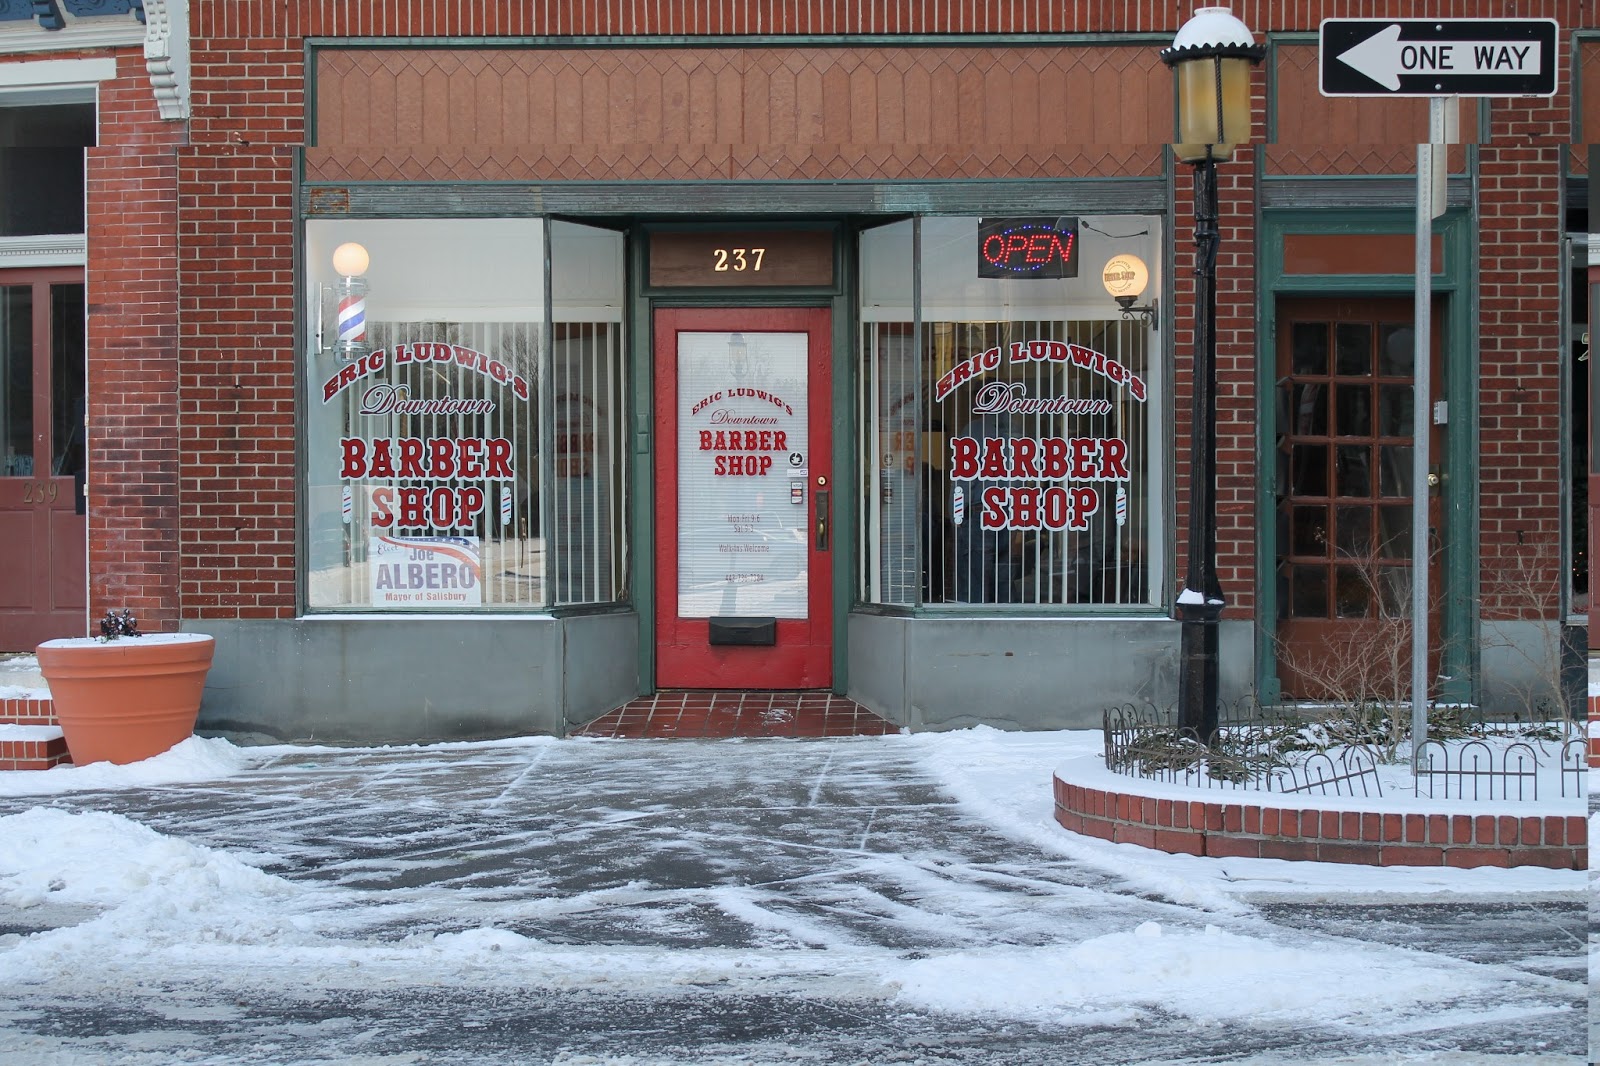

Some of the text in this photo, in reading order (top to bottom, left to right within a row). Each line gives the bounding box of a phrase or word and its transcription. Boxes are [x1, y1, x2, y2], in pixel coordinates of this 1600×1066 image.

[1401, 46, 1530, 70] ONE WAY
[714, 248, 766, 272] 237
[983, 234, 1074, 263] OPEN
[323, 342, 530, 404] ERIC LUDWIG'S
[935, 340, 1147, 402] ERIC LUDWIG'S
[359, 384, 496, 416] Downtown
[692, 388, 793, 416] ERIC LUDWIG'S
[972, 381, 1112, 414] Downtown
[709, 408, 780, 425] Downtown
[699, 430, 788, 450] BARBER
[339, 437, 514, 481] BARBER
[714, 455, 772, 476] SHOP
[950, 436, 1130, 482] BARBER
[24, 481, 58, 504] 239
[370, 486, 485, 531] SHOP
[980, 486, 1098, 531] SHOP
[378, 543, 399, 555] Elect
[410, 548, 434, 561] Joe
[744, 544, 770, 553] Welcome
[376, 563, 476, 589] ALBERO
[386, 592, 466, 601] Mayor of Salisbury
